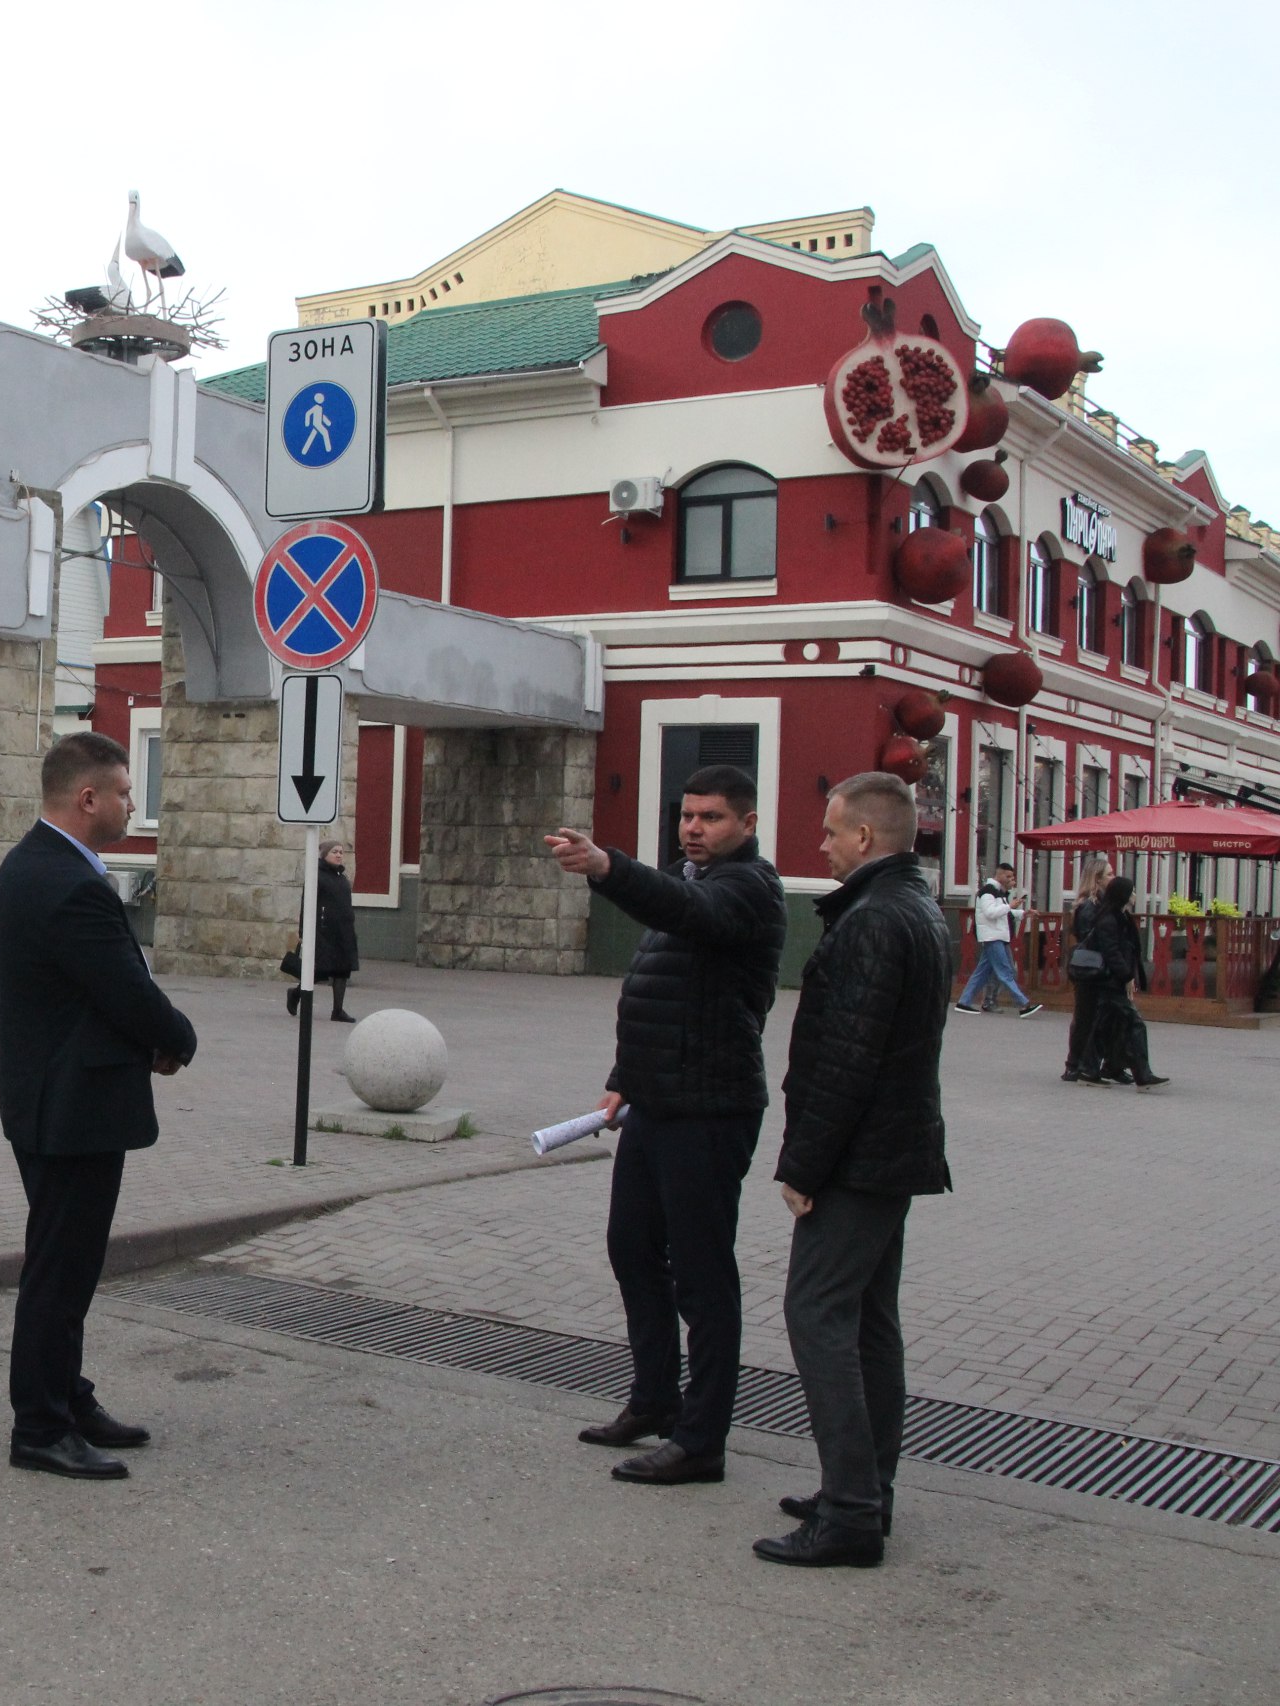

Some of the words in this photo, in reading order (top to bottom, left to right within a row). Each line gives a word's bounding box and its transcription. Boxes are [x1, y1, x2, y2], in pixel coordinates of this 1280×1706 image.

[288, 334, 354, 362] ЗОНА
[1040, 837, 1090, 846] СЕМЕЙНОЕ
[1212, 840, 1252, 849] БИСТРО
